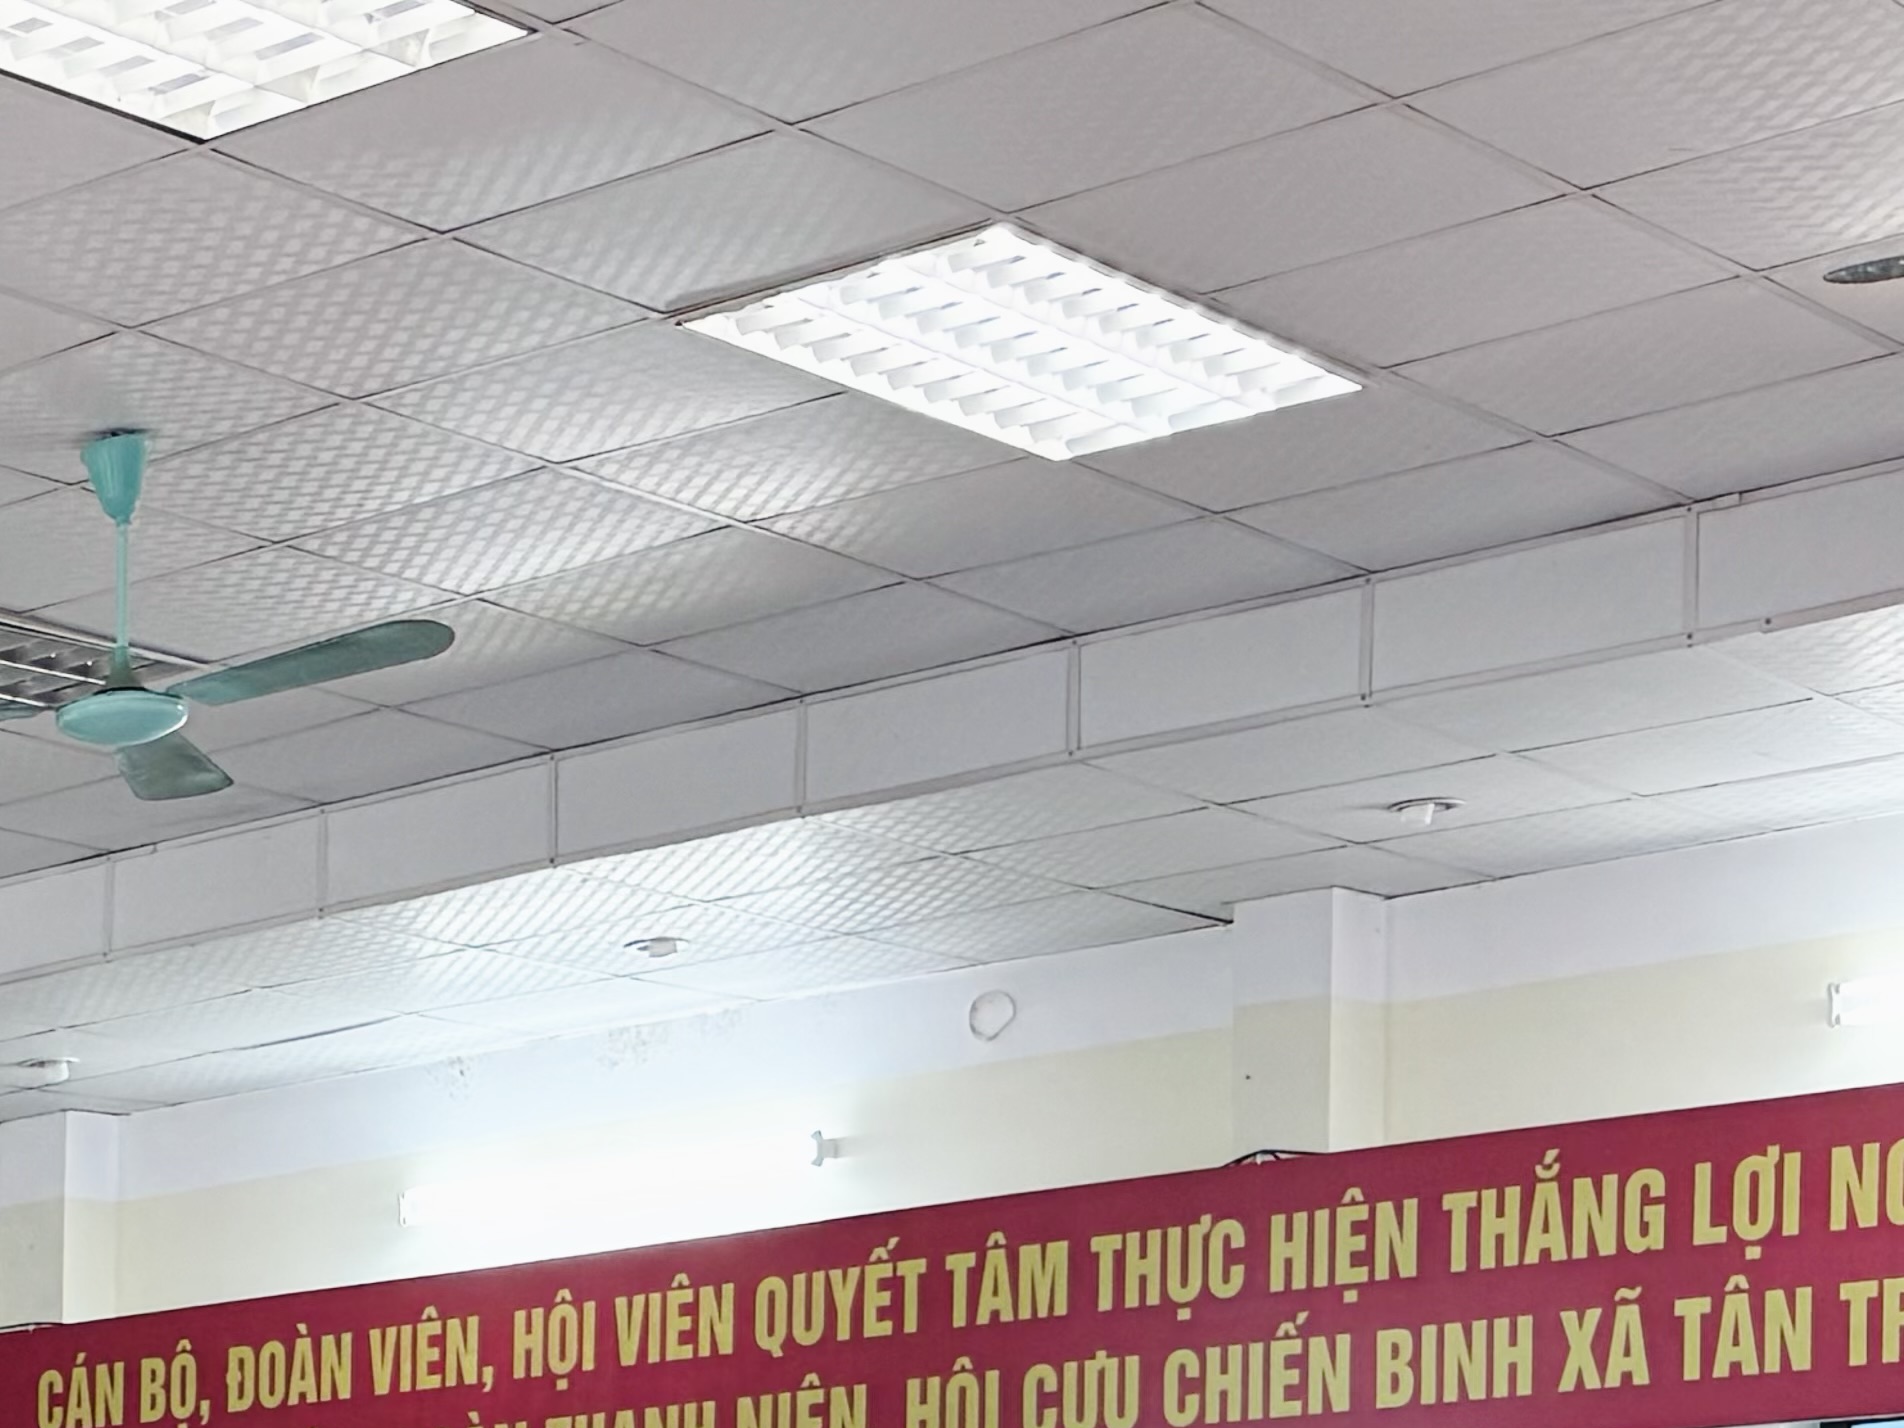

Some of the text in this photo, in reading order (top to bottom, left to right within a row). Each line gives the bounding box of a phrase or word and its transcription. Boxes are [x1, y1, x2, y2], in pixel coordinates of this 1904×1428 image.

[140, 1339, 210, 1422] BỘ,
[225, 1331, 352, 1413] ĐOÀN
[370, 1308, 494, 1395] VIÊN,
[512, 1289, 595, 1388] HỘI
[615, 1273, 735, 1366] VIÊN
[754, 1246, 926, 1357] QUYẾT
[946, 1231, 1068, 1327] TÂM
[1090, 1215, 1244, 1318] THỰC
[1269, 1188, 1416, 1300] HIỆN
[1443, 1152, 1665, 1272] THẮNG
[1692, 1144, 1801, 1260] LỢI
[1163, 1325, 1349, 1427] CHIẾN
[1375, 1316, 1532, 1407] BINH
[1558, 1287, 1650, 1390] XÃ
[1674, 1274, 1812, 1380] TÂN
